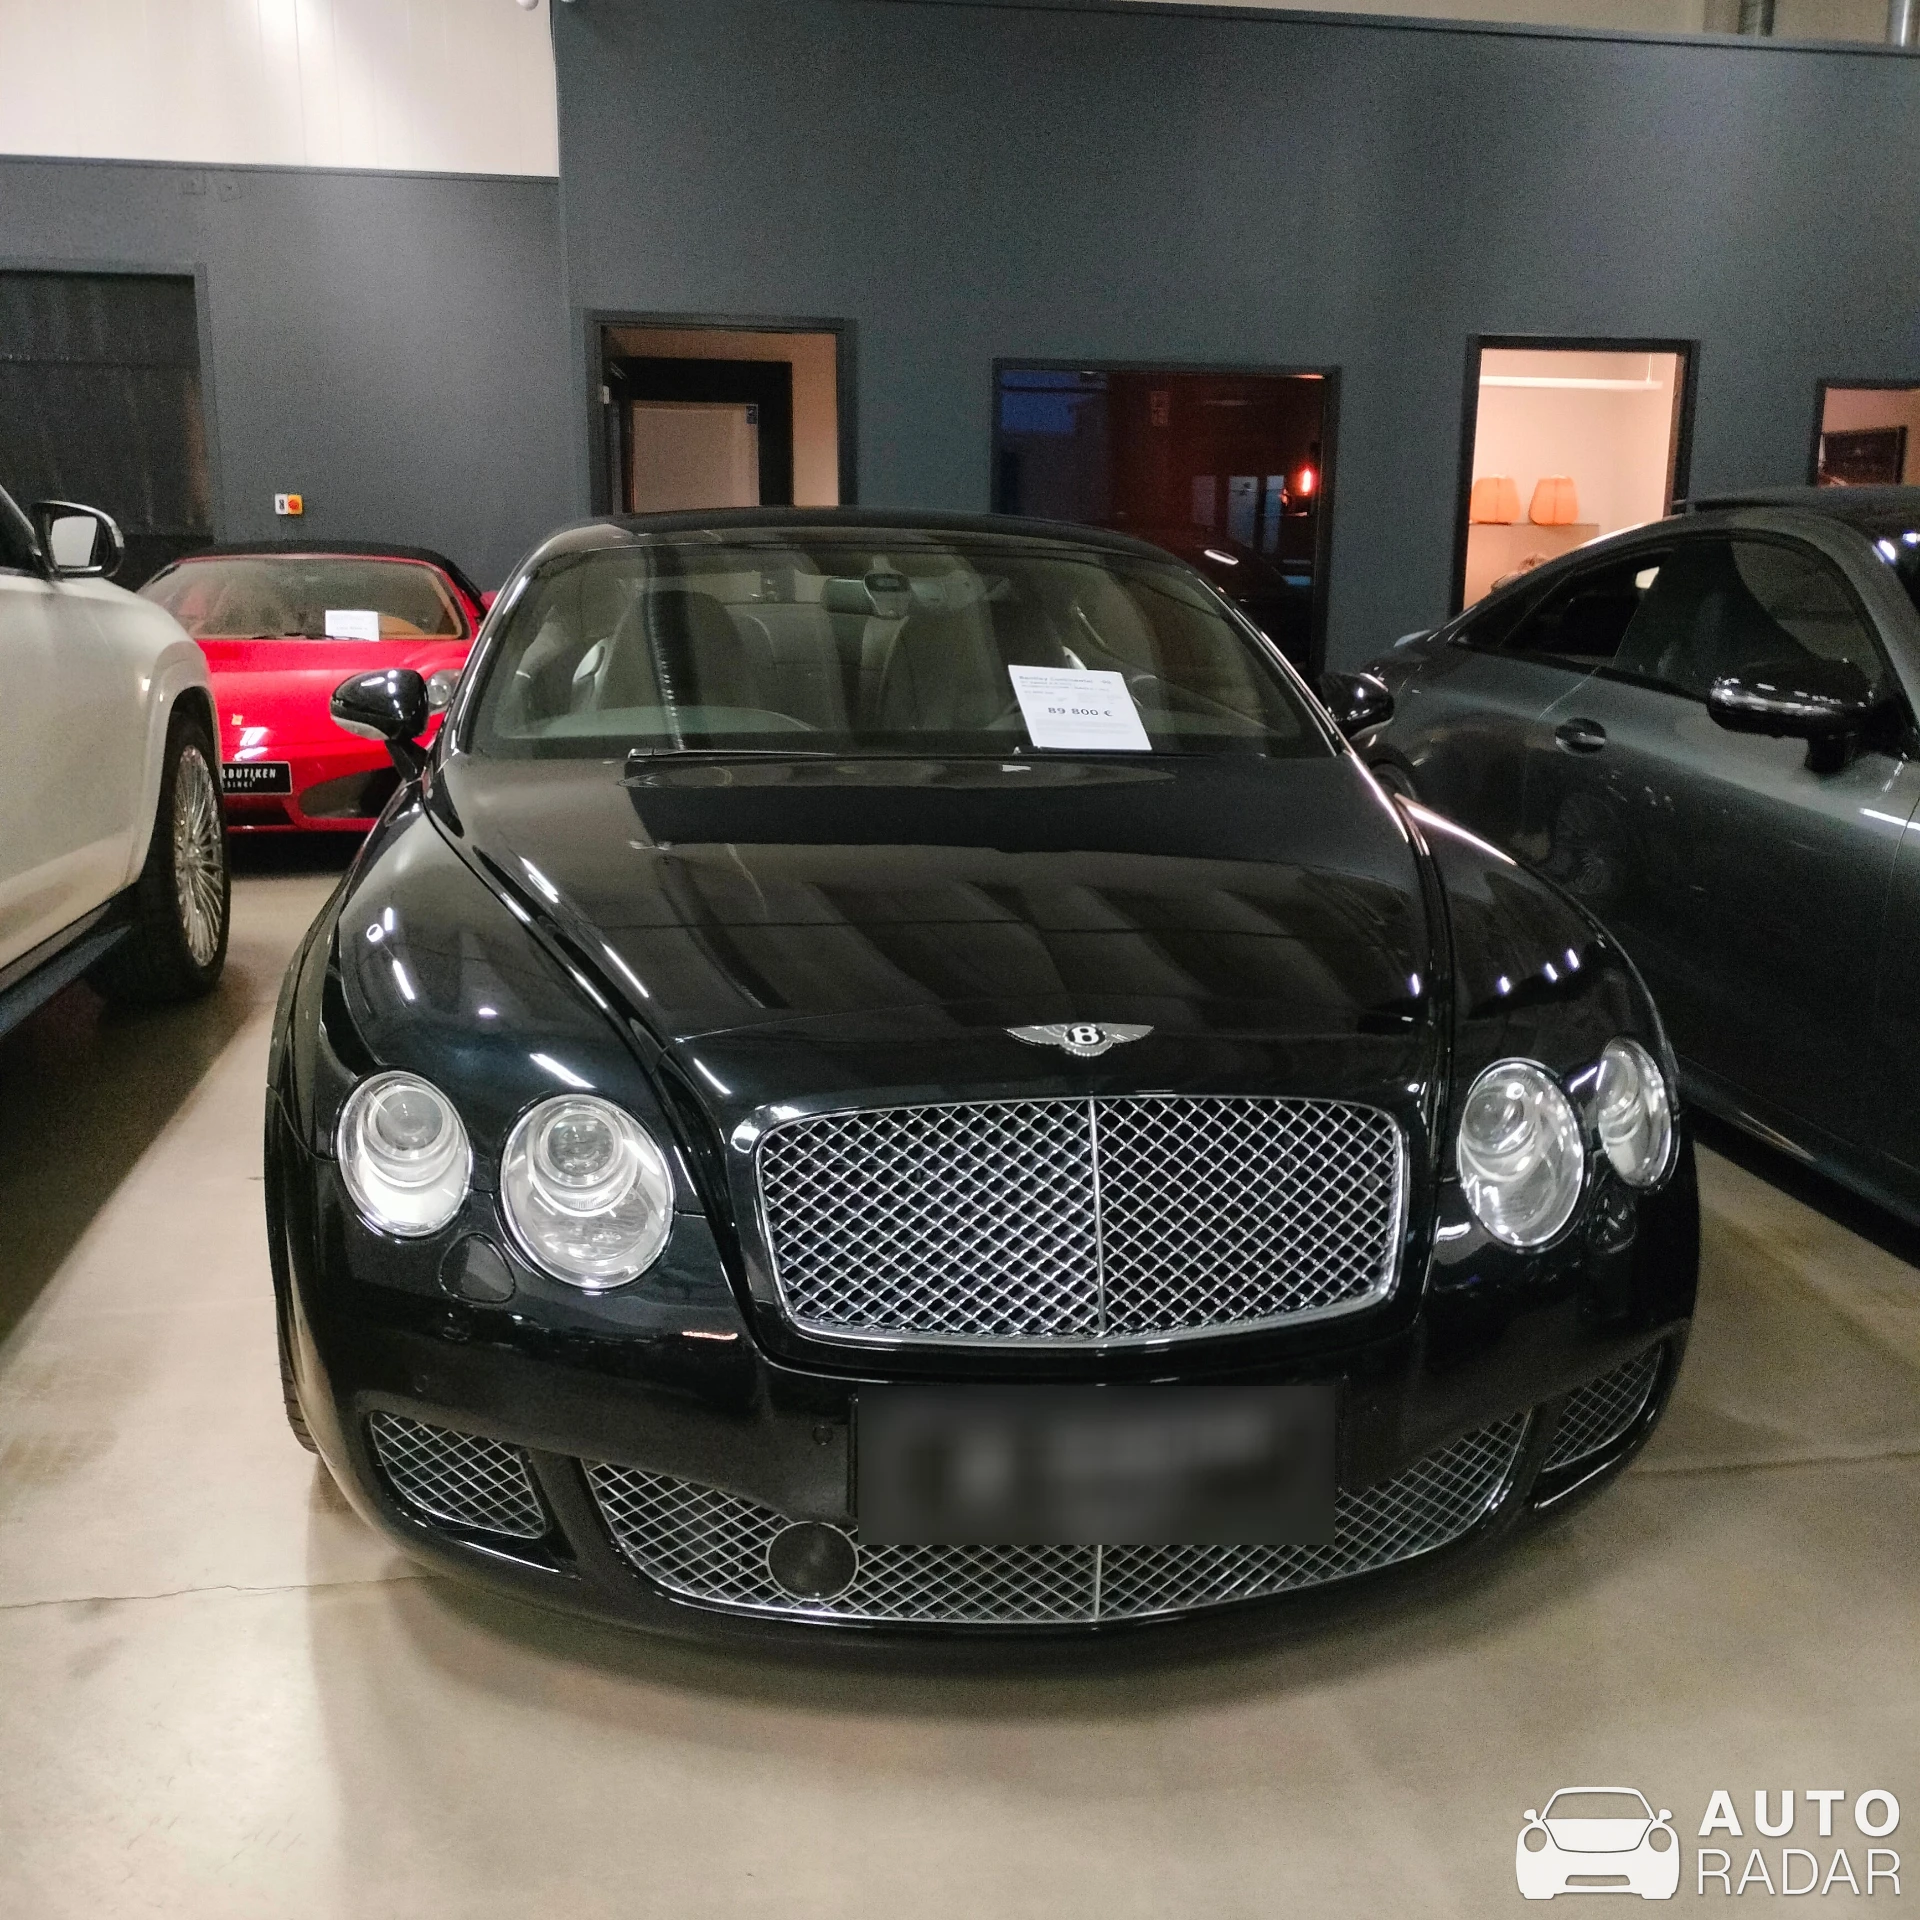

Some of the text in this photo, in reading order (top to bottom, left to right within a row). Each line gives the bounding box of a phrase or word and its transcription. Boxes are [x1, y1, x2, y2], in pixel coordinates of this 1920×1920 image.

[1047, 706, 1113, 717] 89 800 €
[1071, 1025, 1099, 1045] B
